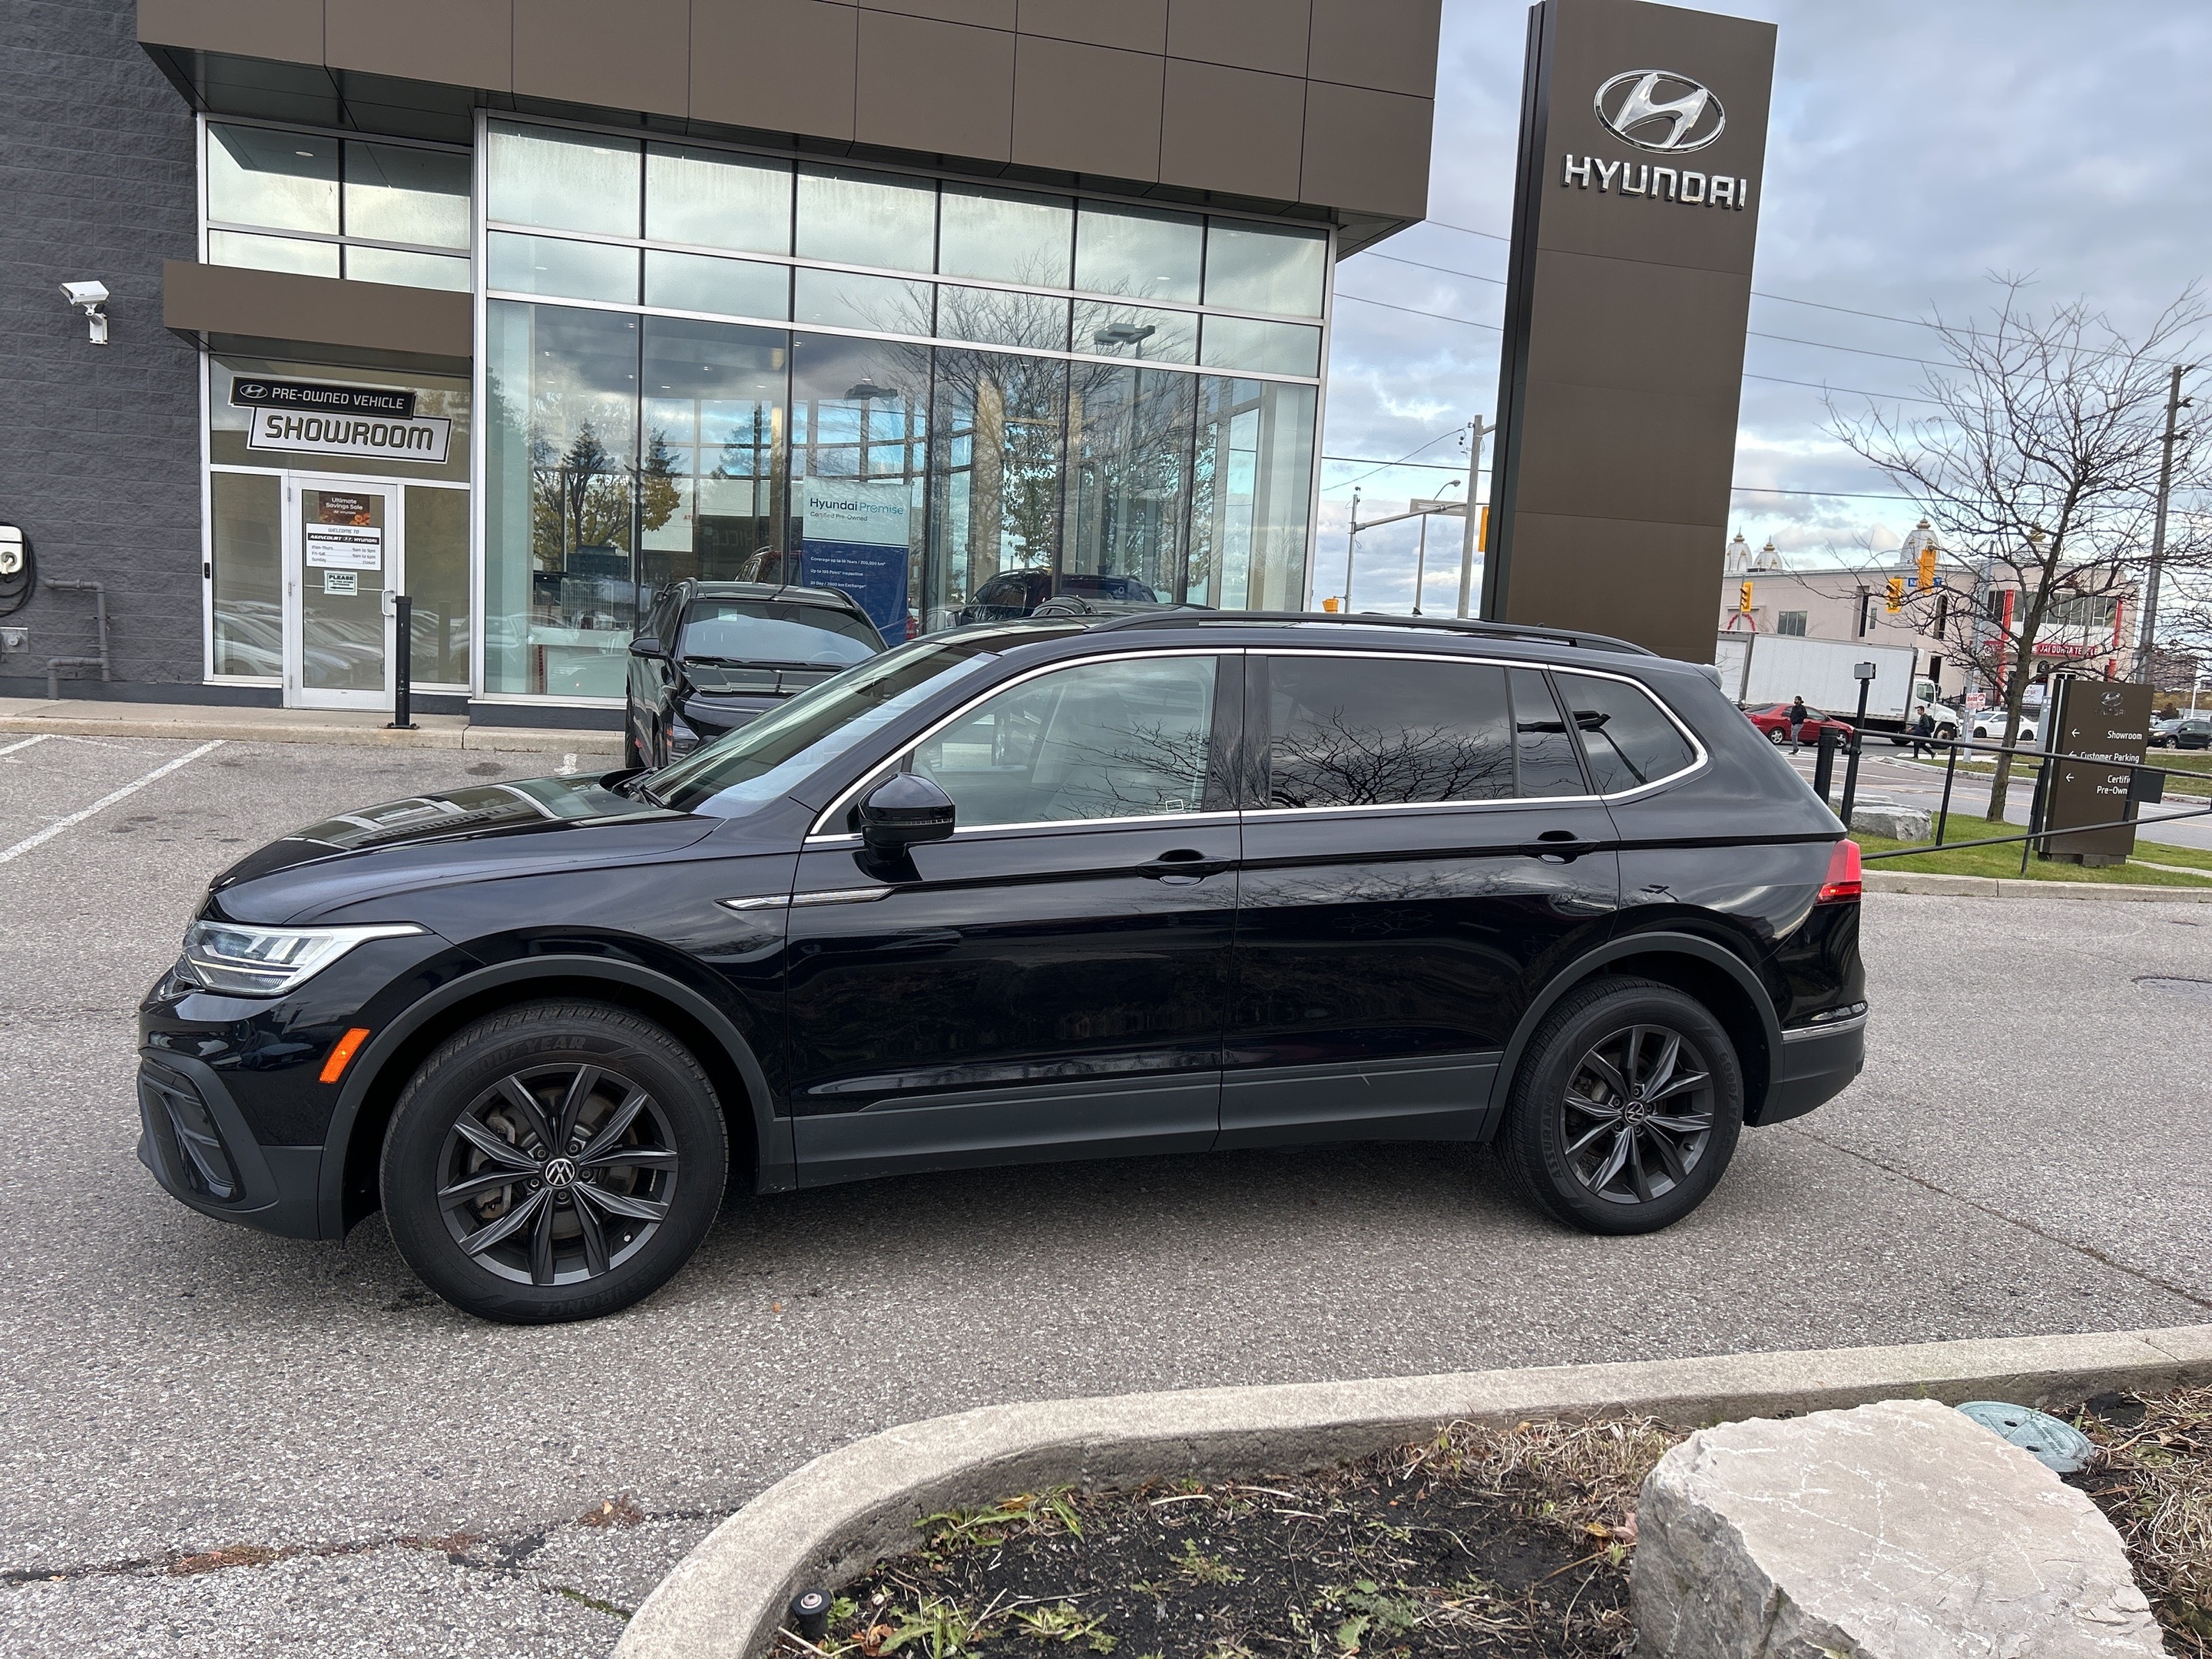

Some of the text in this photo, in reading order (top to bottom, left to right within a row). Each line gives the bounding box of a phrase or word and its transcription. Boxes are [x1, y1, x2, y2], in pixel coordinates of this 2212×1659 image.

[1561, 154, 1747, 210] HYUNDAI
[271, 386, 405, 409] PRE-OWNED VEHICLE
[264, 414, 435, 451] SHOWROOM
[810, 498, 904, 515] Hyundai Promise
[2107, 730, 2143, 740] Showroom
[2080, 751, 2140, 764] Customer Parking
[2108, 774, 2131, 784] Certifi
[2096, 785, 2128, 795] Pre-Own
